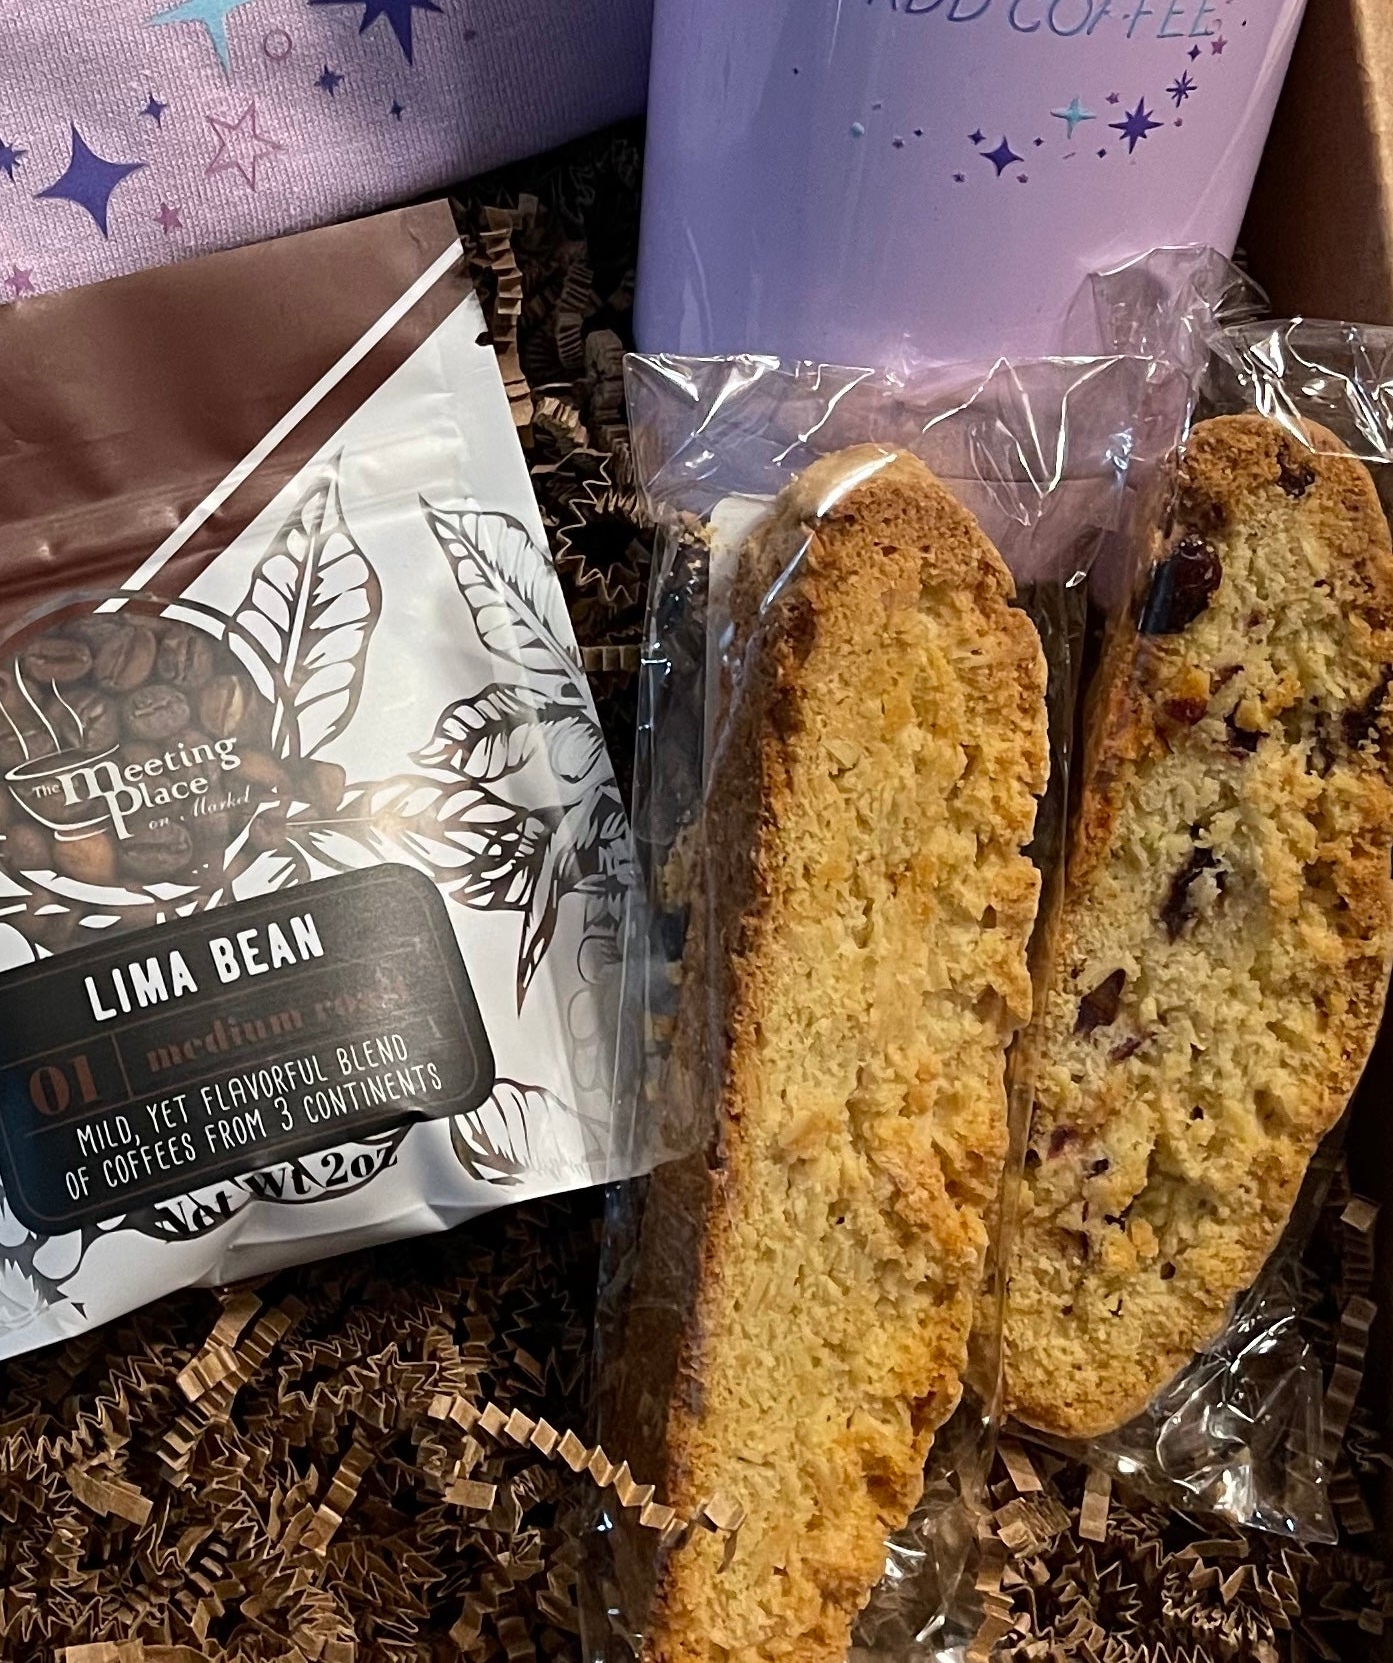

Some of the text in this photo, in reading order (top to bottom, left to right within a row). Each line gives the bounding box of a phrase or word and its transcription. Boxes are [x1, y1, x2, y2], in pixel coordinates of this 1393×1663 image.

[32, 783, 59, 799] The
[148, 817, 169, 830] on
[84, 913, 324, 1021] LIMA BEAN
[29, 977, 409, 1116] 01 medium roat
[77, 1034, 408, 1157] MILD, YET FLAVORFUL BLEND
[66, 1062, 442, 1201] OF COFFEES FROM 3 CONTINENTS
[242, 1166, 312, 1198] Wt
[320, 1147, 398, 1188] 2oz
